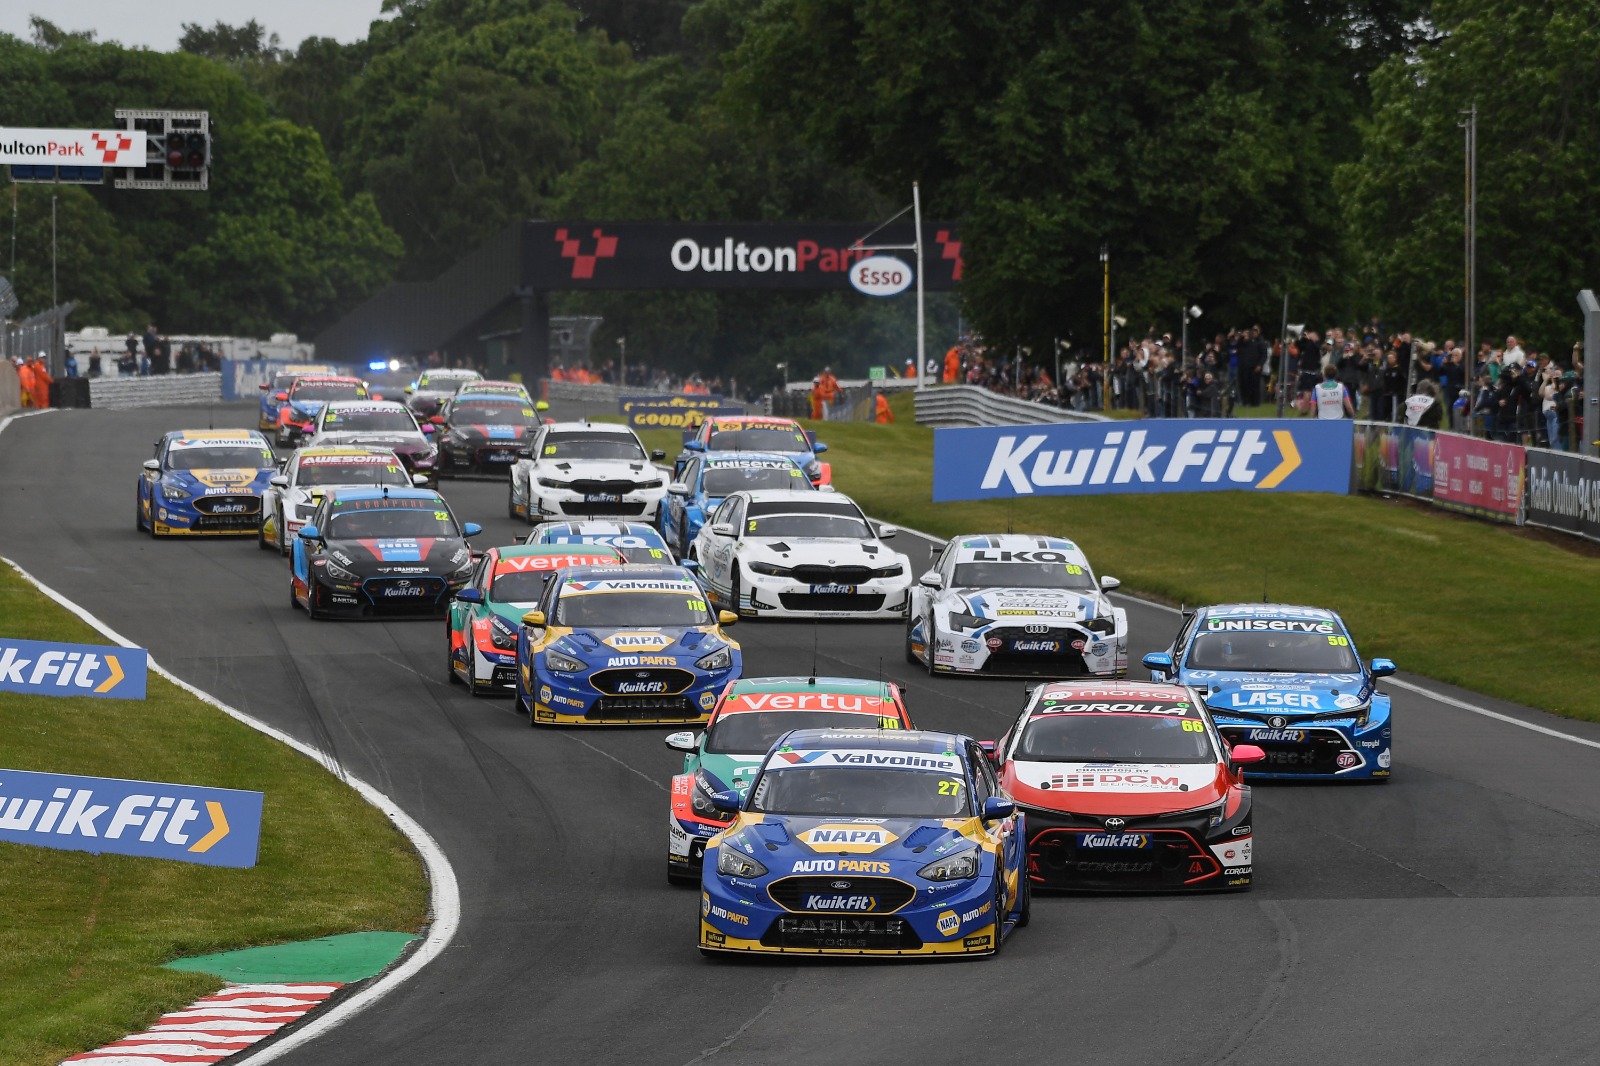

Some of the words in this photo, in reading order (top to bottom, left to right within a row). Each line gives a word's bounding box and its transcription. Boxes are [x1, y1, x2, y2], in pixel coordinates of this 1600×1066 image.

[0, 141, 84, 156] ultonPark
[859, 267, 903, 286] Esso
[302, 455, 393, 465] AWESOME
[204, 487, 226, 495] AUTO
[1530, 466, 1551, 512] Radio
[1552, 470, 1578, 518] Oulton
[434, 511, 449, 521] 22
[748, 520, 758, 532] 2
[973, 550, 1070, 564] LKQ
[1065, 563, 1082, 576] 88
[606, 581, 694, 591] Valvoline
[687, 599, 707, 612] 116
[614, 636, 665, 645] NAPA
[1327, 635, 1348, 647] 50
[607, 656, 639, 667] AUTO
[640, 656, 677, 666] PARTS
[1232, 692, 1322, 710] LASER
[1042, 703, 1188, 716] COROLLA
[1265, 706, 1289, 714] TOOLS
[1181, 719, 1204, 733] 66
[831, 753, 954, 770] Valvoline
[1338, 753, 1355, 767] STP
[1099, 774, 1179, 787] DCM
[937, 780, 960, 796] 27
[0, 782, 200, 845] wikFit
[813, 830, 882, 844] NAPA
[791, 859, 836, 873] AUTO
[837, 859, 891, 874] PARTS
[711, 905, 727, 919] AUTO
[726, 911, 749, 926] PARTS
[962, 908, 980, 923] AUTO
[939, 915, 959, 931] NAPA
